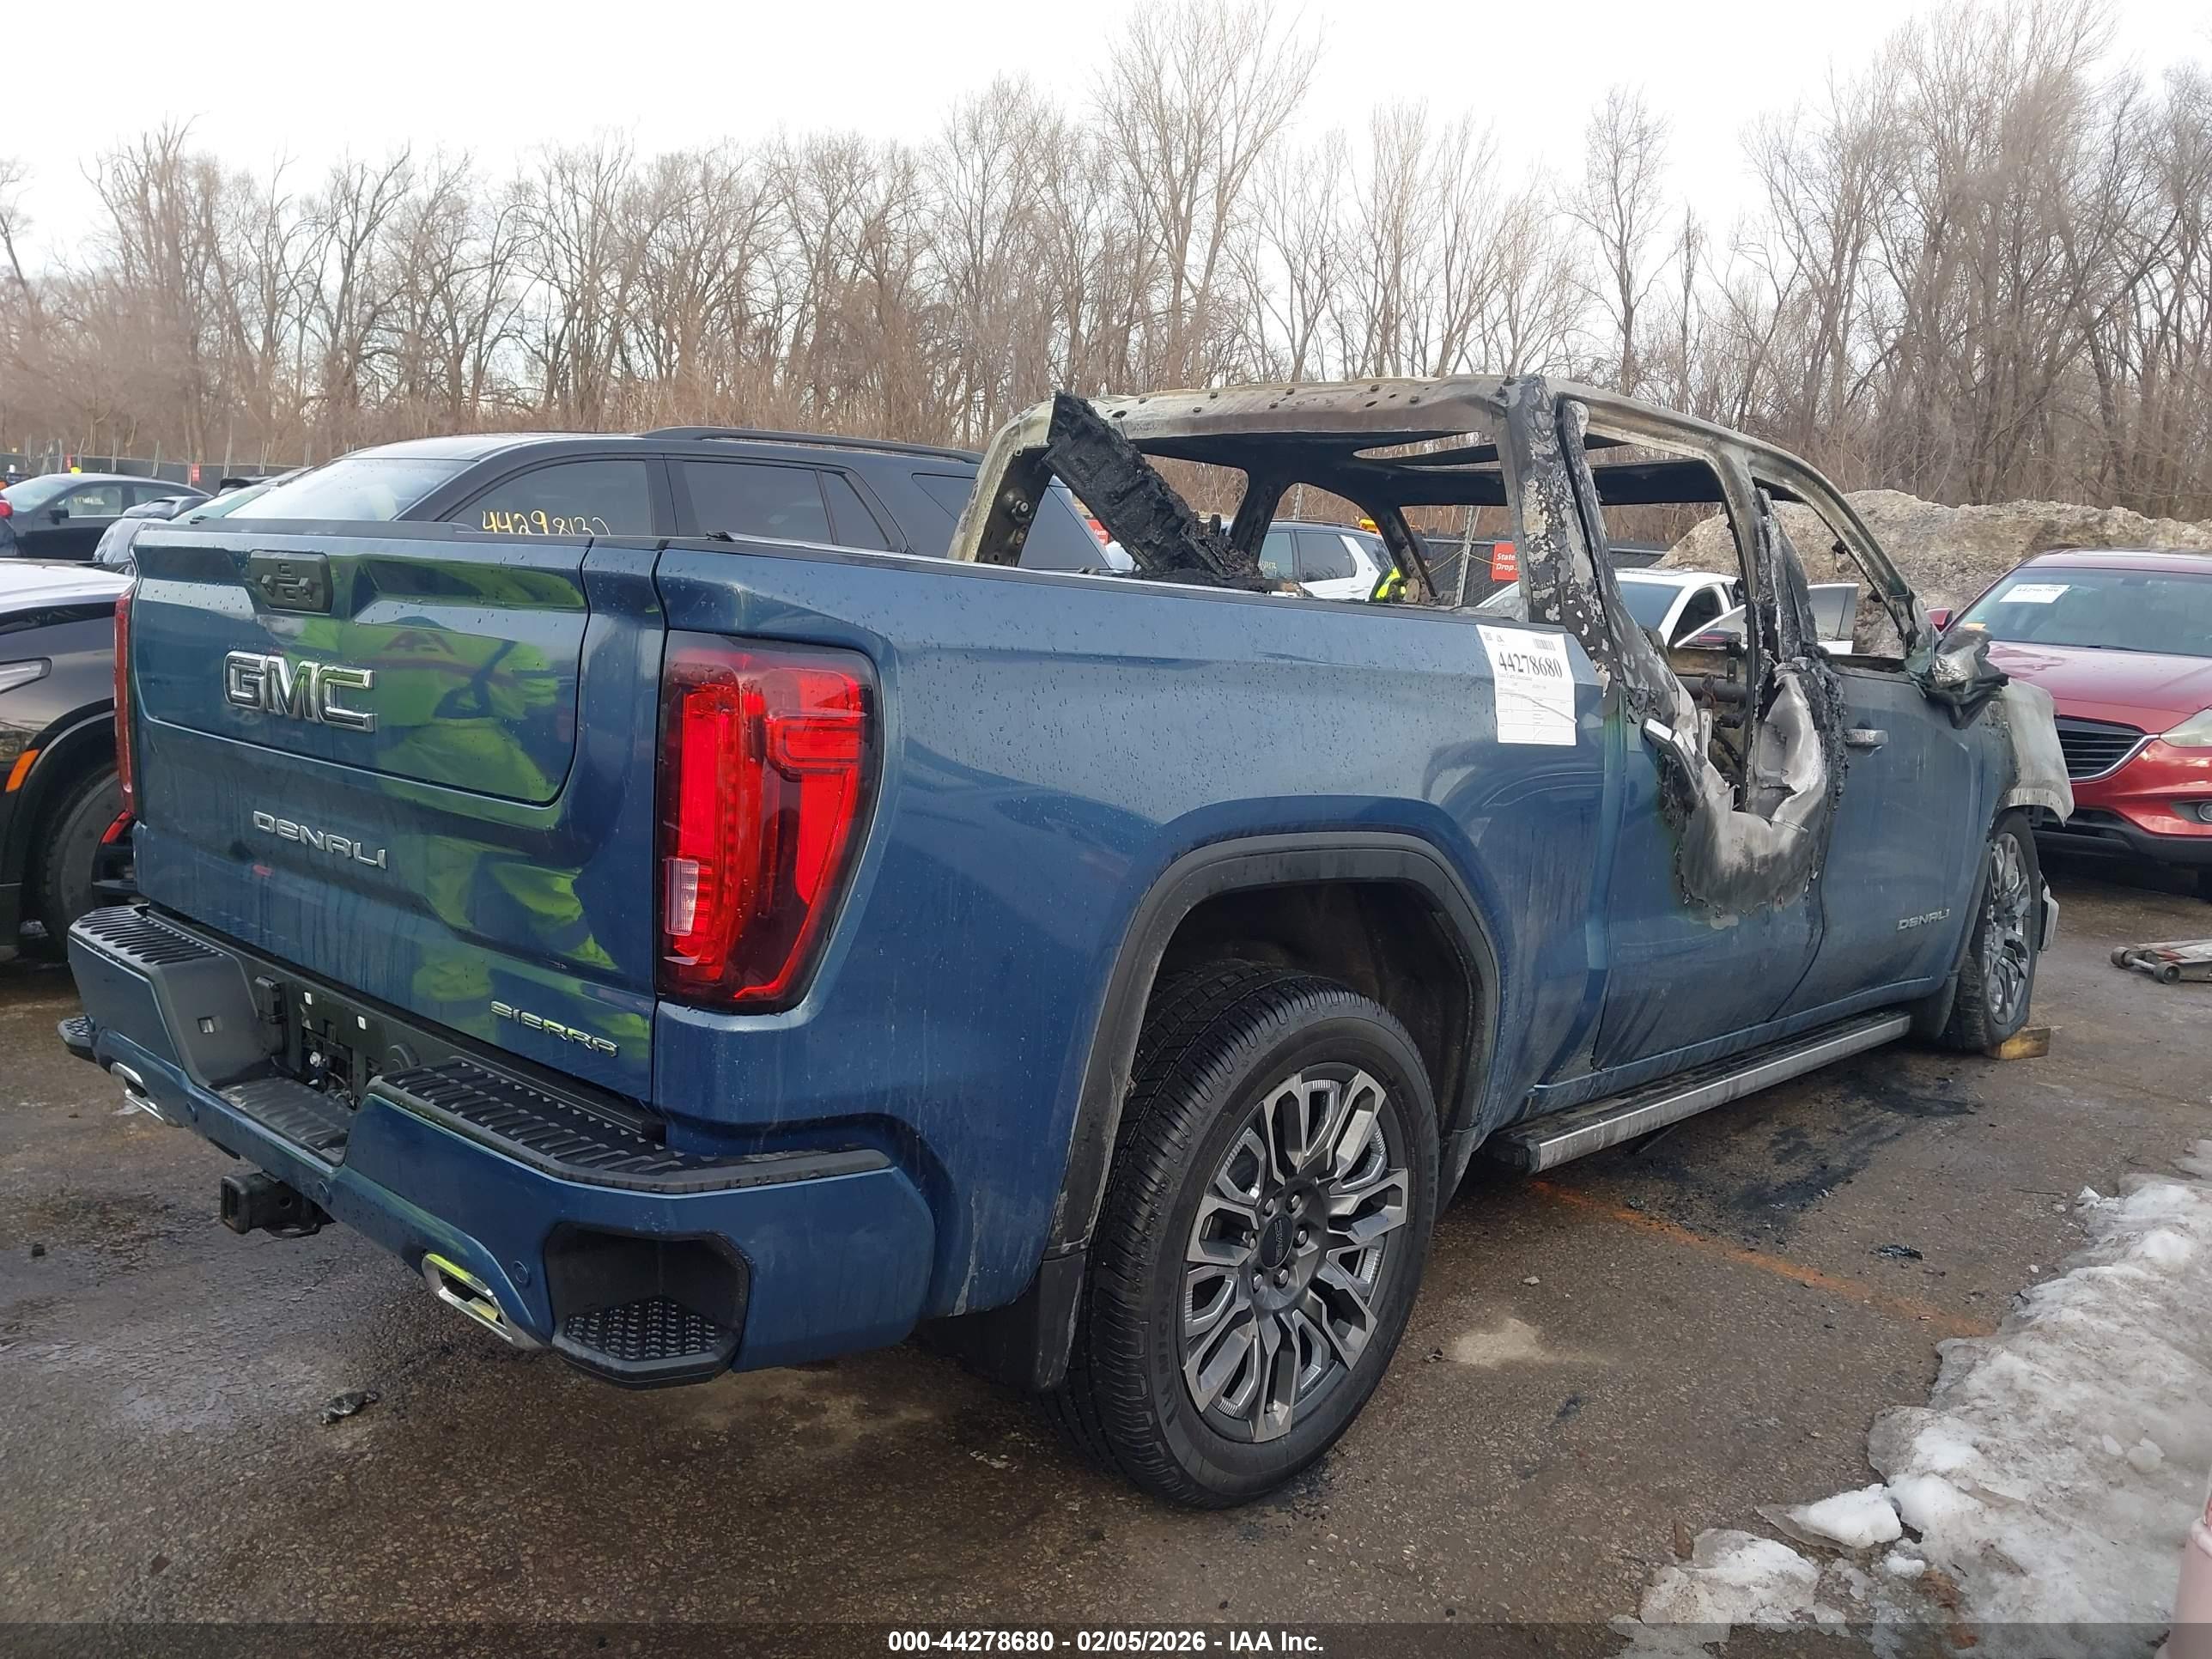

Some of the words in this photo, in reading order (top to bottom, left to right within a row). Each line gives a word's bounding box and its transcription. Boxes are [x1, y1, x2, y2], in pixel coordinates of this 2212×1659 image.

[1496, 552, 1516, 561] State
[1498, 652, 1563, 678] 44278680
[224, 650, 376, 732] GMC
[252, 810, 387, 870] DENALI
[1896, 908, 1950, 931] DENALI
[490, 1000, 619, 1057] SIERRA
